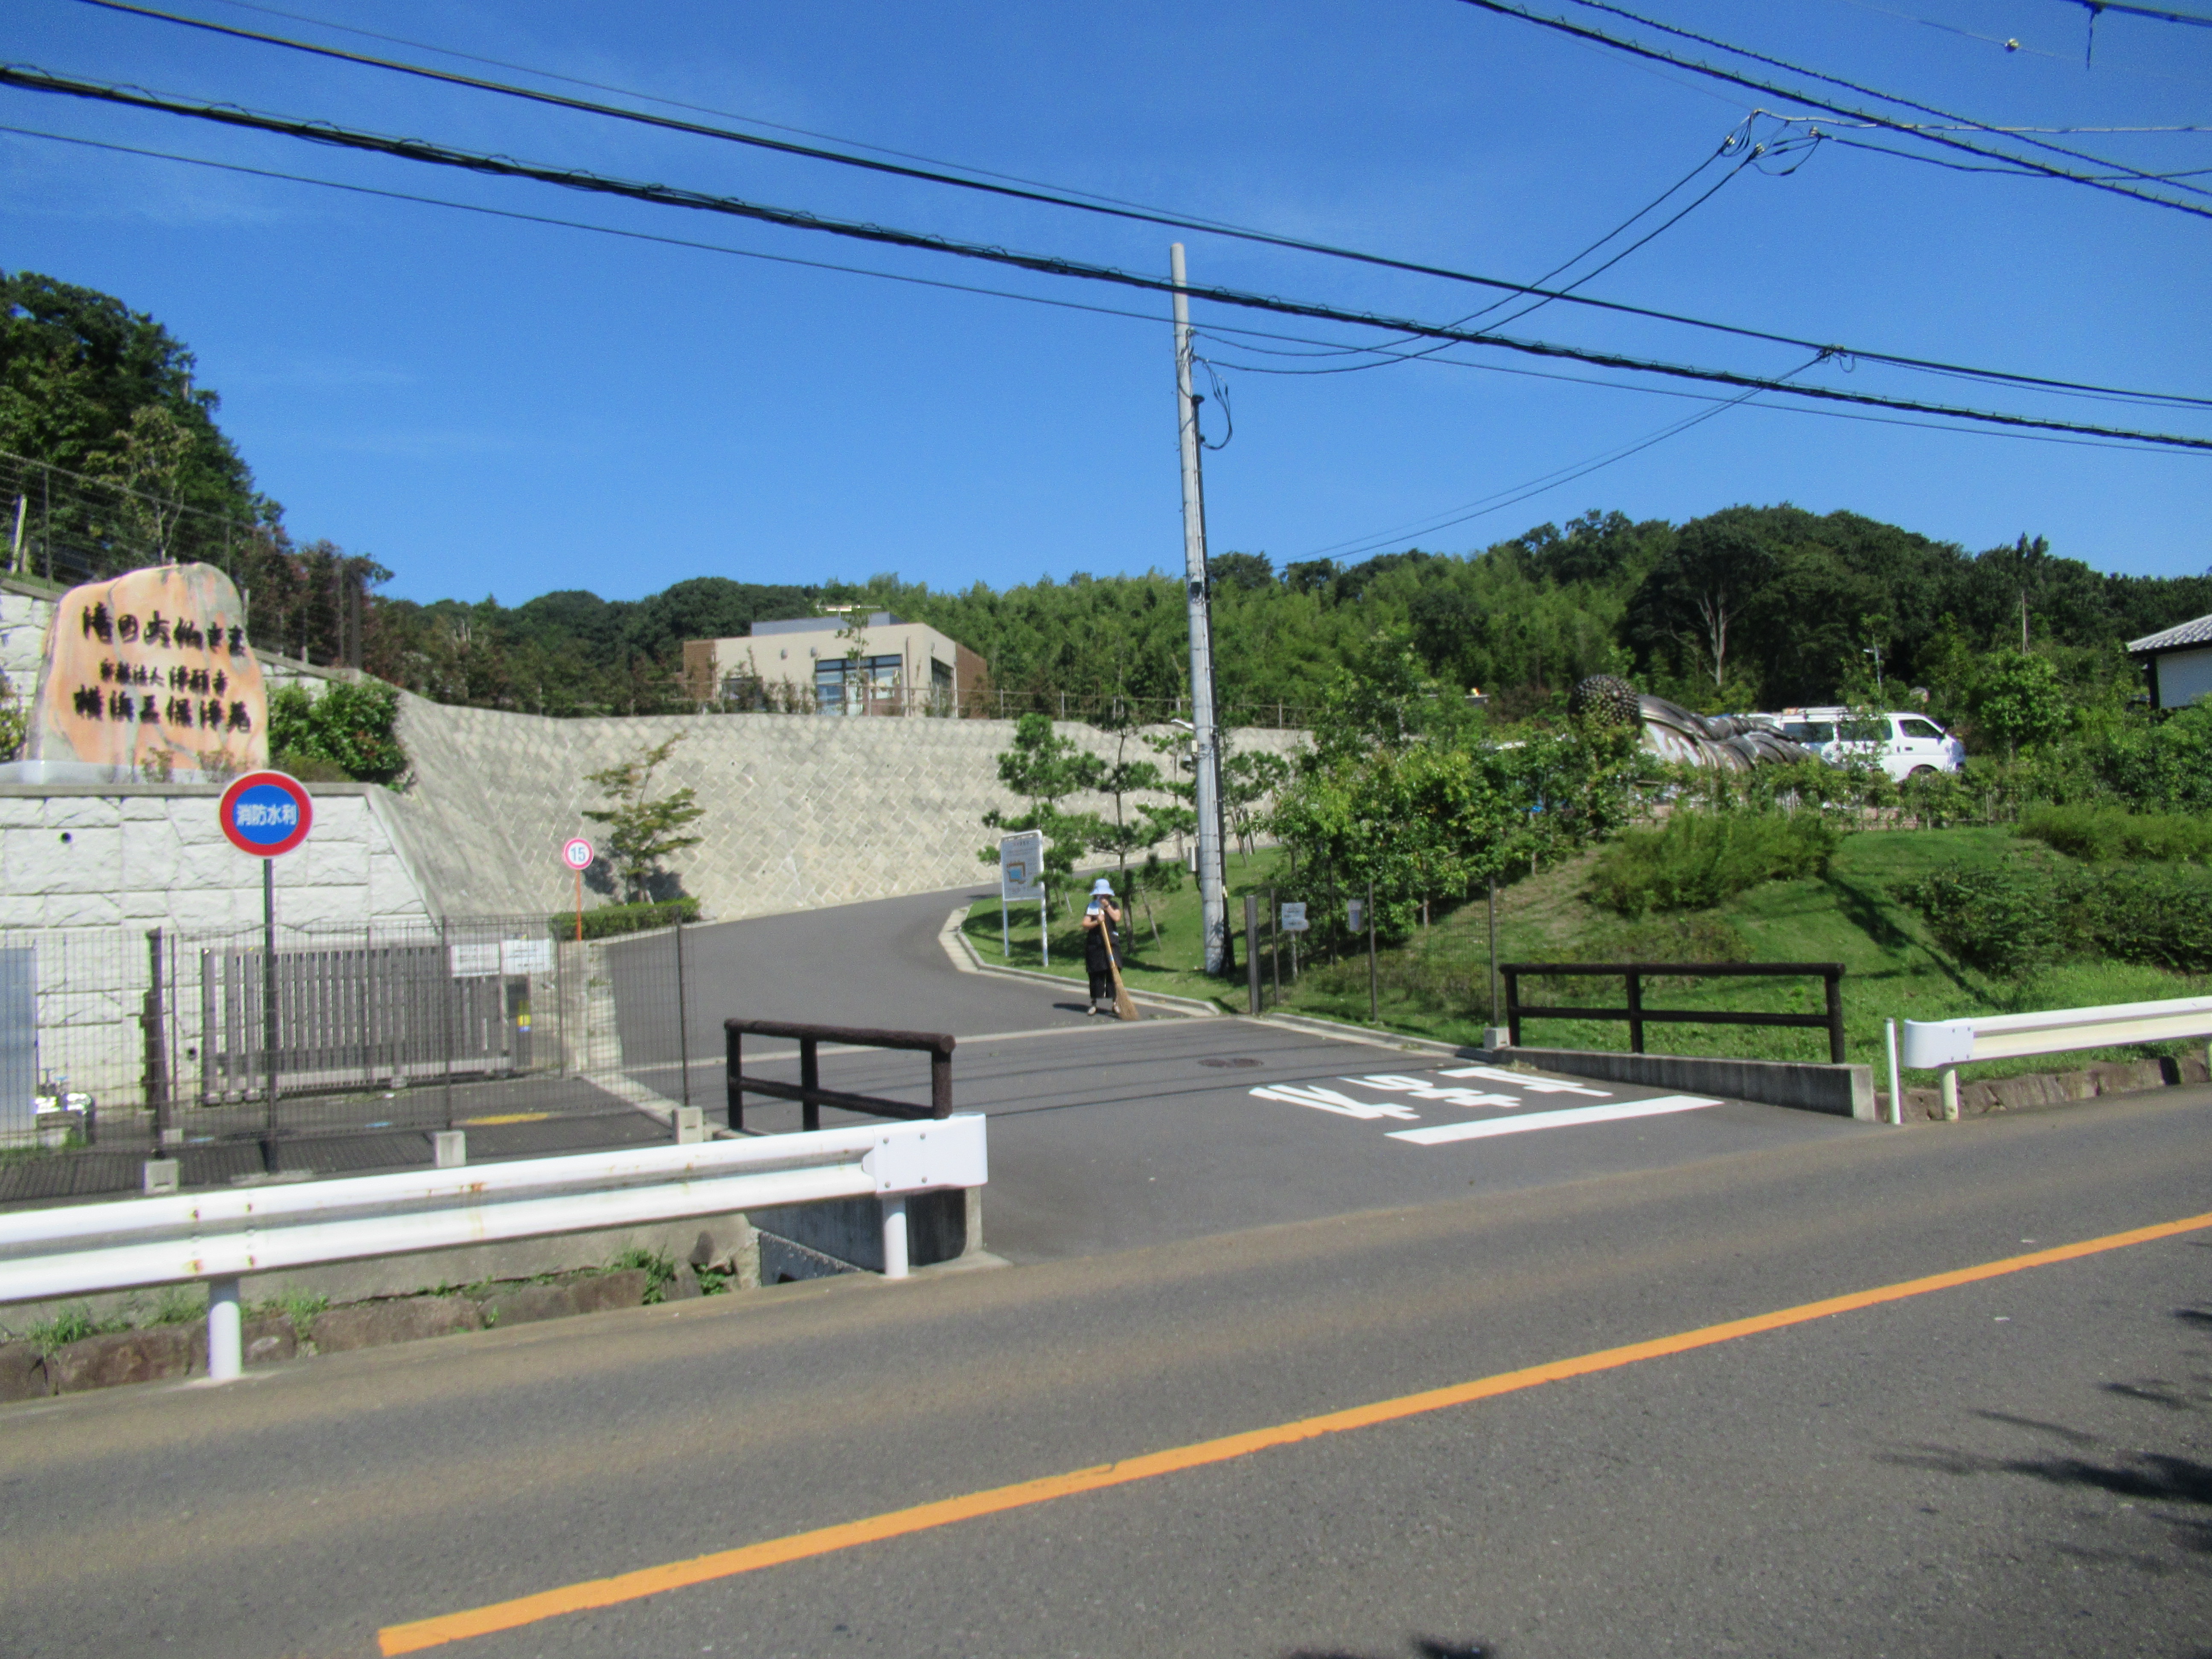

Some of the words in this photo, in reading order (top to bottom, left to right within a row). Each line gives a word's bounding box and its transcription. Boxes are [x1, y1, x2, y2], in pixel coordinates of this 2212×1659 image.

[236, 803, 297, 826] 消防水利
[570, 846, 586, 862] 15
